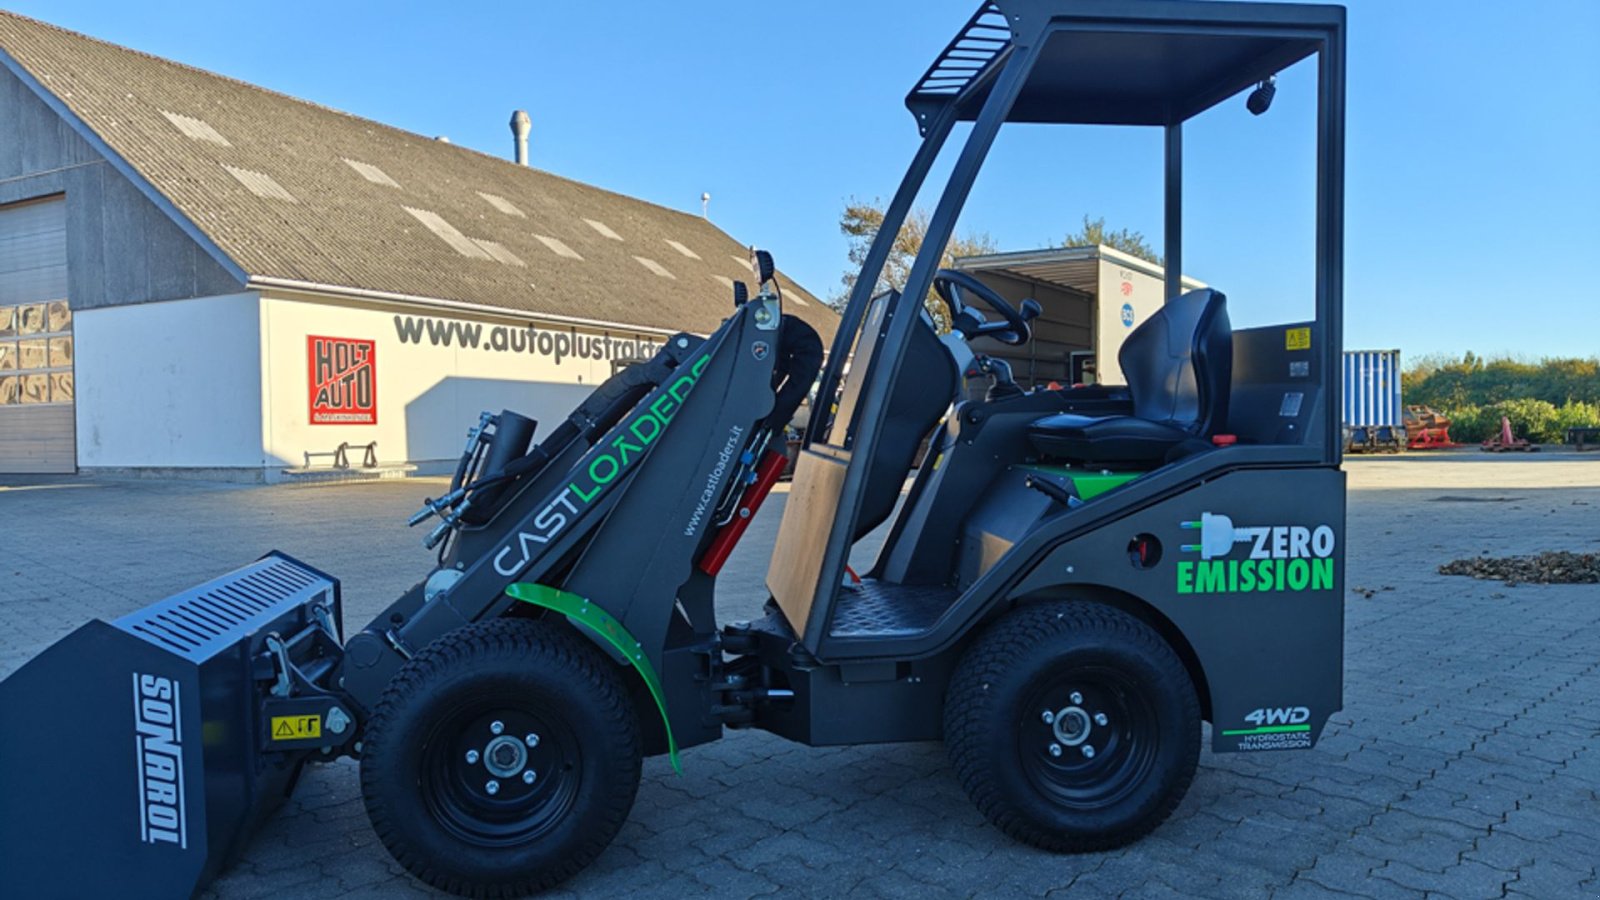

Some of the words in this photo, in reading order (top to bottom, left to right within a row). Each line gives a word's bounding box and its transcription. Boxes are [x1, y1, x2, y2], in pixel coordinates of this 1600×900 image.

[315, 339, 371, 387] HOLT
[313, 363, 371, 408] AUTO
[684, 424, 743, 536] www.castloaders.it
[1250, 525, 1335, 559] ZERO
[1177, 558, 1334, 593] EMISSION
[1244, 706, 1310, 725] 4WD
[1238, 740, 1311, 750] TRANSMISSION
[1243, 732, 1310, 742] HYDROSTATIC
[133, 672, 187, 849] SONAROL
